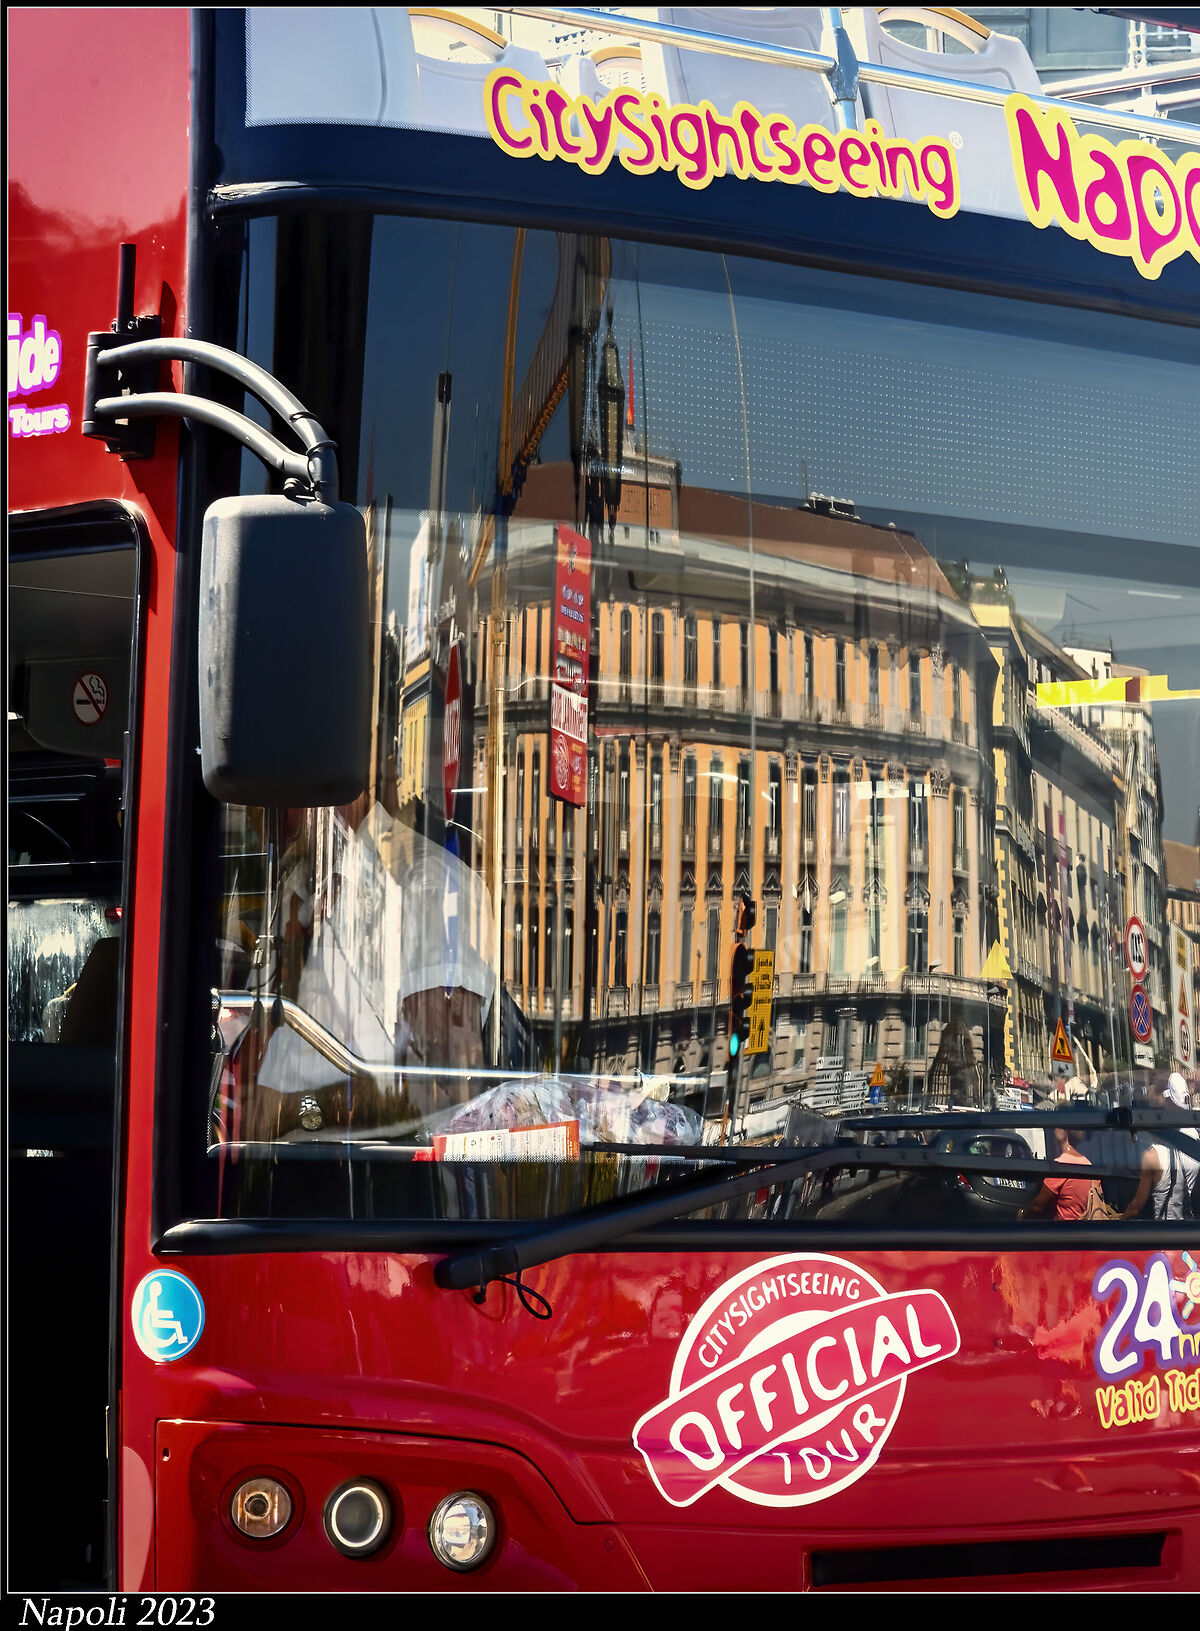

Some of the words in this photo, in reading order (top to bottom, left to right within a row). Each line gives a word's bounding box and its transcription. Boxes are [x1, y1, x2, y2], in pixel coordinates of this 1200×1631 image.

[487, 71, 959, 216] CitySightseeing
[9, 406, 69, 436] Tours
[699, 1272, 860, 1368] CITYSIGHTSEEING
[1098, 1260, 1180, 1374] 24
[669, 1304, 942, 1471] OFFICIAL
[1096, 1375, 1160, 1429] Valid
[771, 1404, 886, 1484] TOUR
